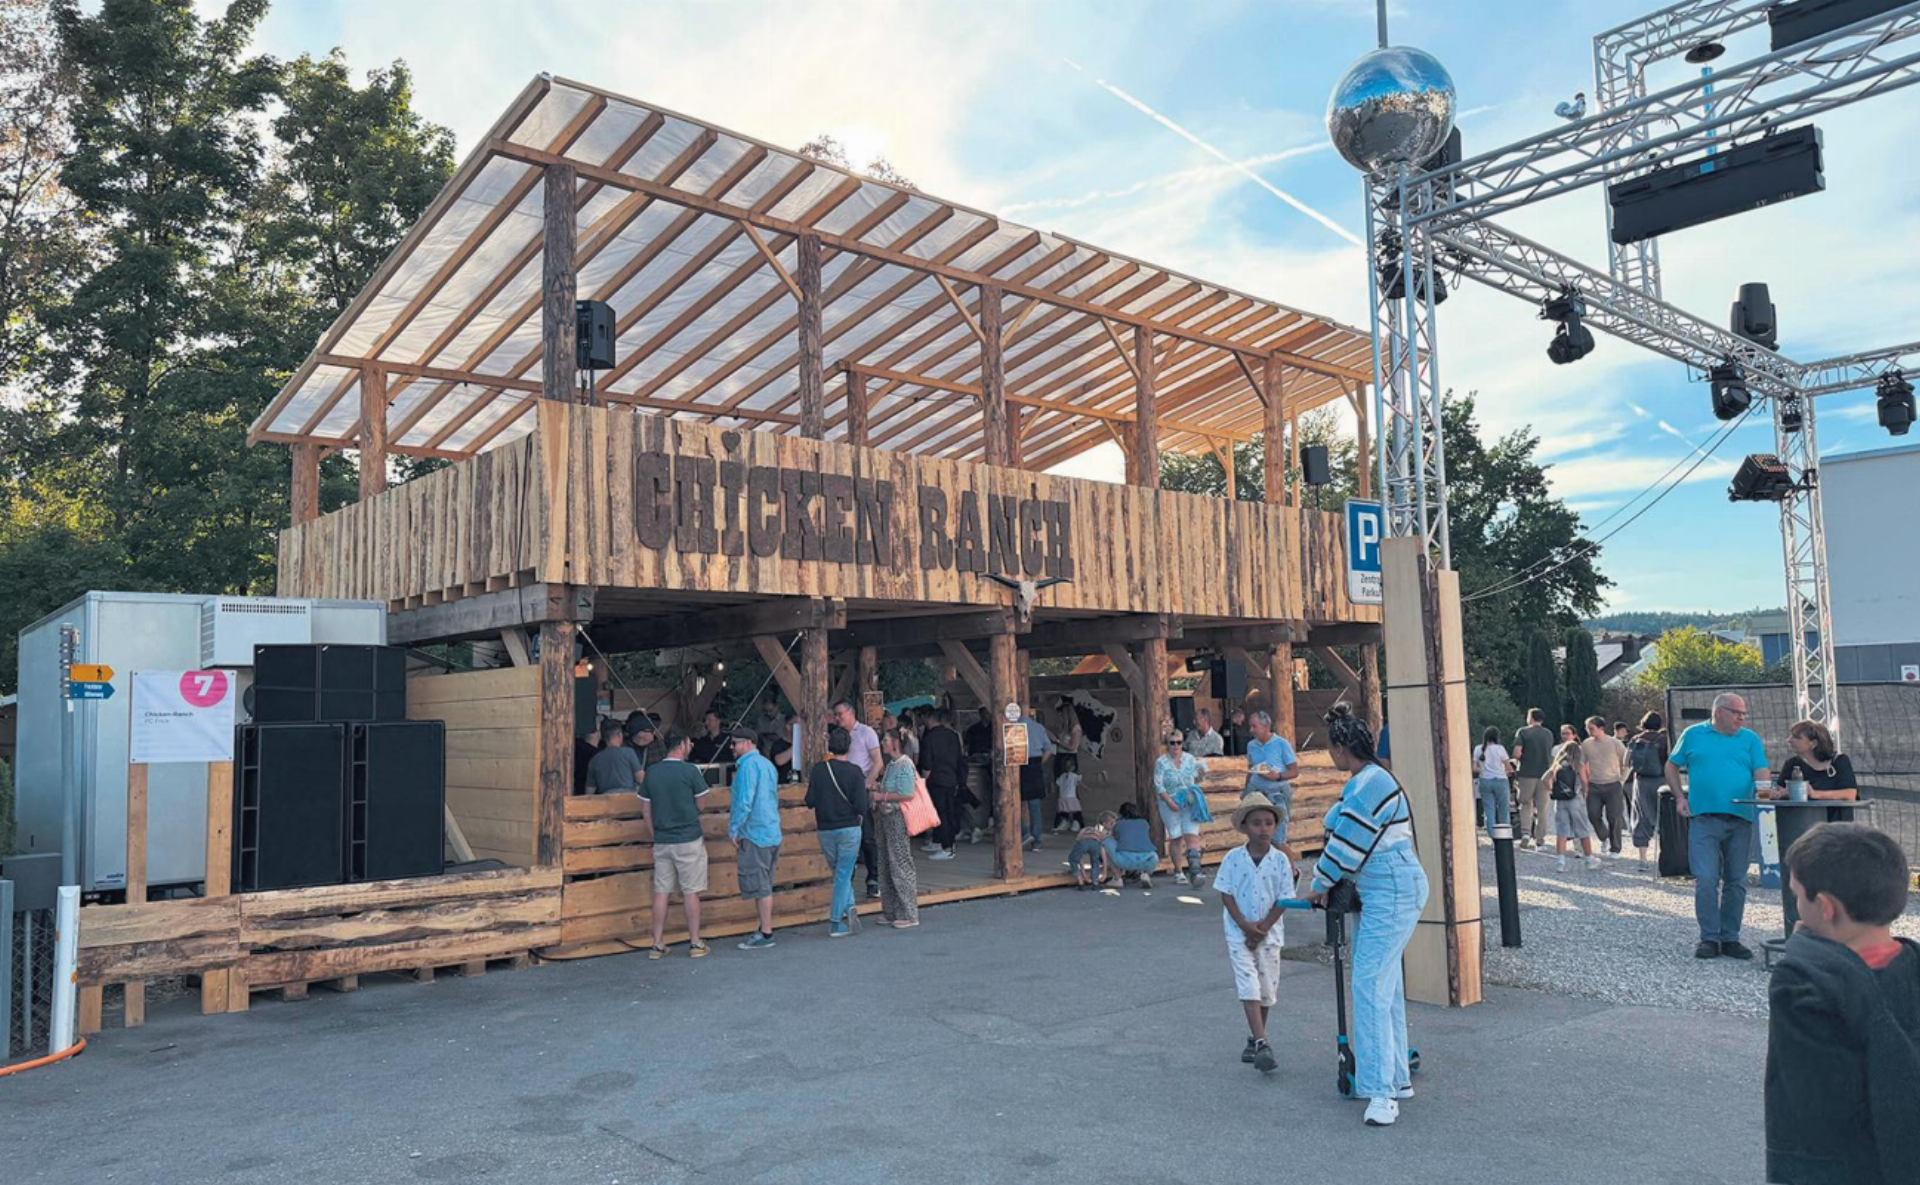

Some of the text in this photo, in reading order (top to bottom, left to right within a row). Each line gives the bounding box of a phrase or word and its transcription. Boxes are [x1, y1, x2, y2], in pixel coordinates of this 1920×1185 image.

[636, 451, 1074, 577] CHICKEN RANCH
[1358, 512, 1379, 560] P
[194, 675, 214, 696] 7
